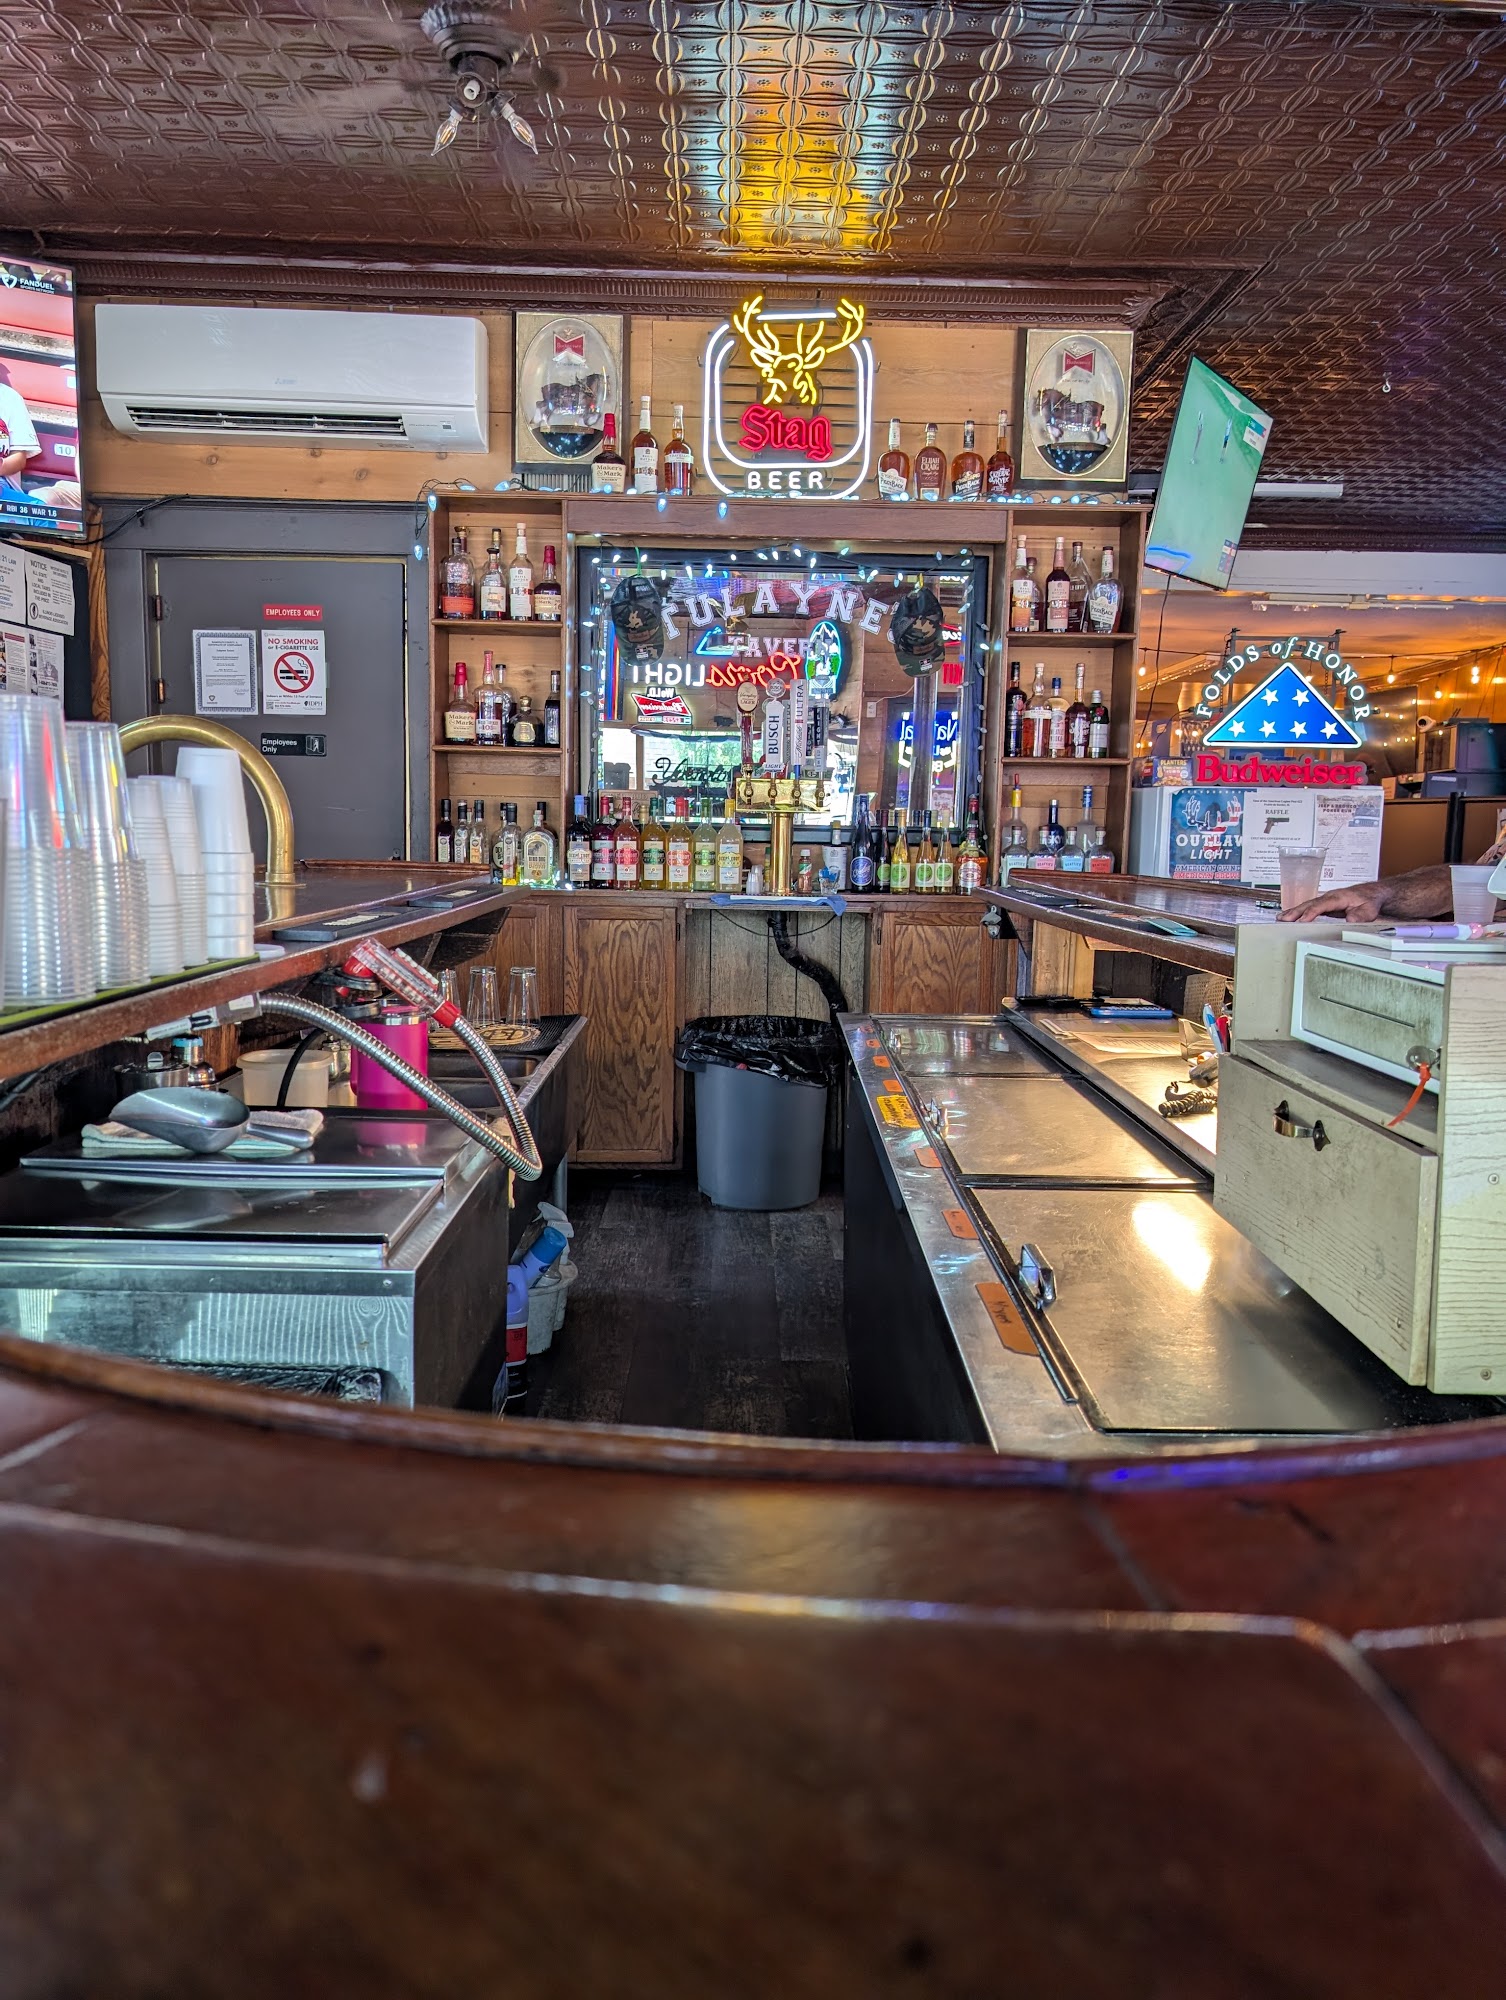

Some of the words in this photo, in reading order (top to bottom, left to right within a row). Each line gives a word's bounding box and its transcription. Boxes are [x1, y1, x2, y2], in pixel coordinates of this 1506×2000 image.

[20, 279, 55, 290] FANDUEL
[738, 404, 833, 462] Stag
[58, 446, 72, 455] 10
[921, 456, 940, 464] ELIJAH
[920, 463, 939, 471] CRAIG
[747, 471, 824, 489] BEER
[6, 505, 18, 513] RBI
[31, 507, 46, 516] WAR
[30, 560, 48, 572] NOTICE
[265, 608, 301, 617] EMPLOYEES
[303, 609, 321, 617] ONLY
[1197, 645, 1260, 719] FOLDS
[1271, 636, 1299, 660] of
[1305, 640, 1370, 721] HONOR
[796, 684, 804, 717] ULTRA
[768, 715, 780, 755] BUSCH
[262, 738, 297, 747] Employees
[262, 746, 277, 754] Only
[1196, 755, 1363, 784] Budweiser
[1190, 849, 1233, 860] LIGHT
[1175, 864, 1217, 872] AMERICAN
